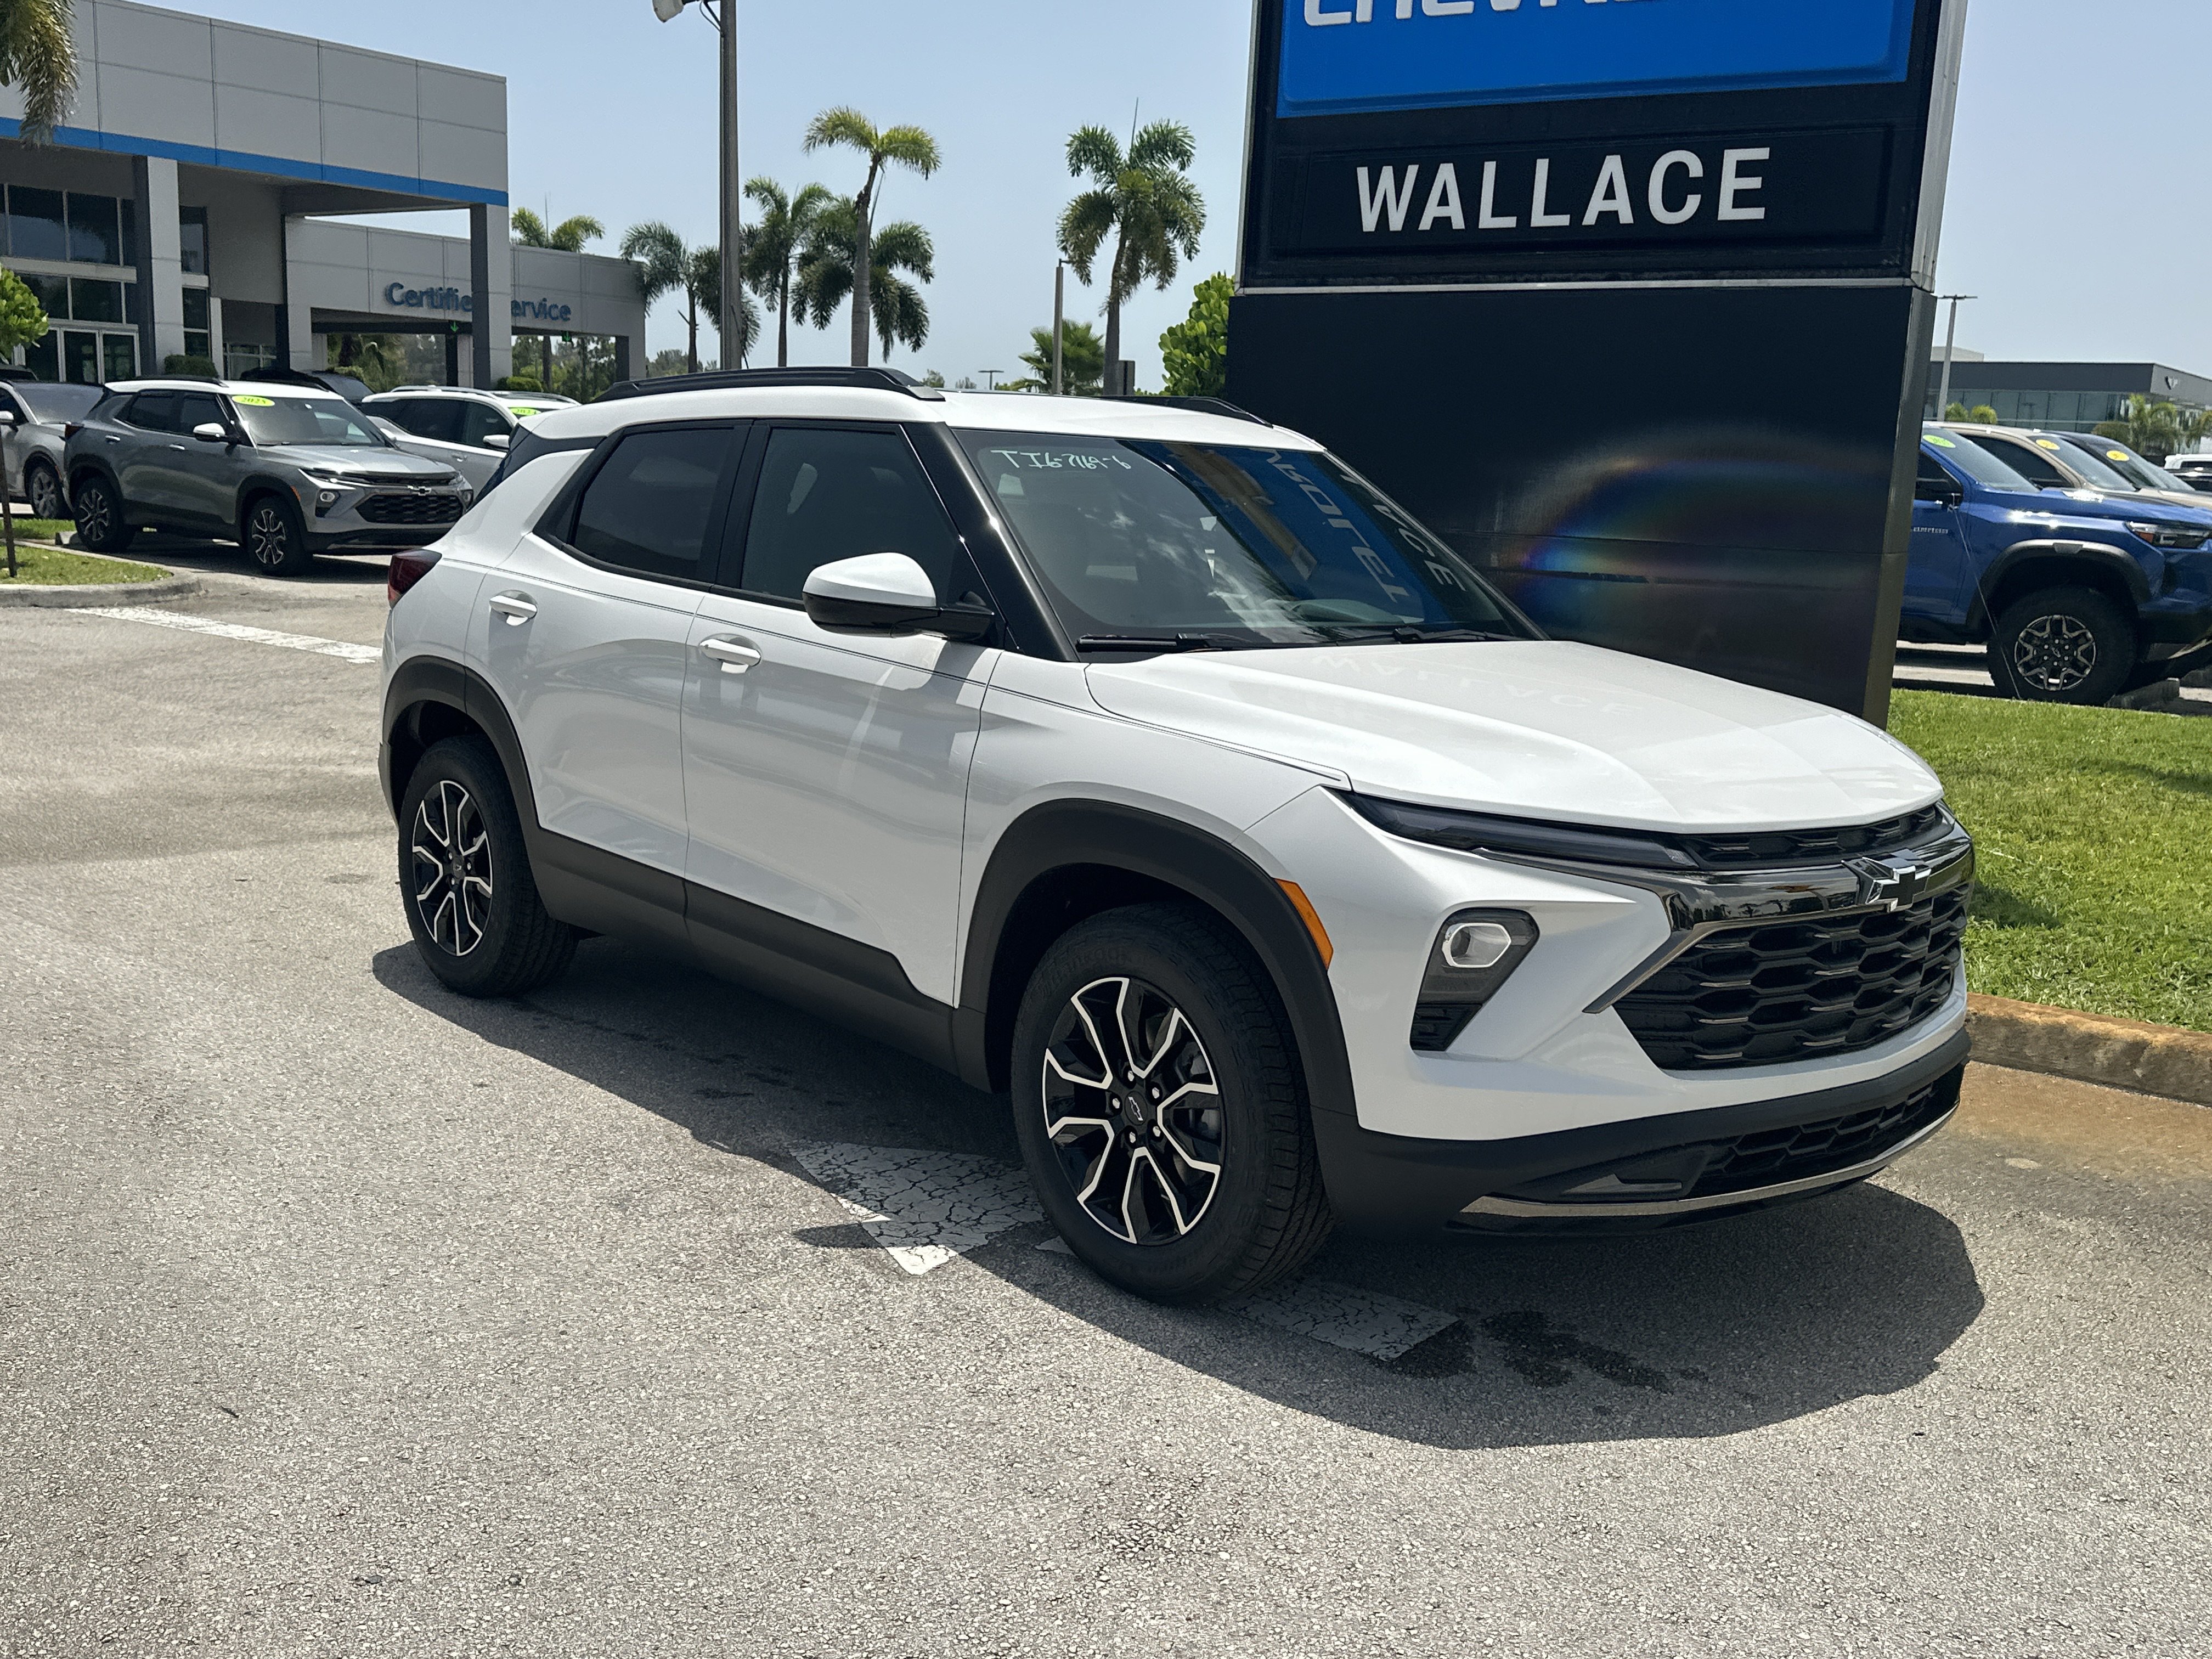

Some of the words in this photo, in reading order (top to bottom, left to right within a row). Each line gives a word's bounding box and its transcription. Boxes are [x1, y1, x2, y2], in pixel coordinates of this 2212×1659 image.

[1356, 146, 1770, 232] WALLACE
[385, 283, 472, 312] Certifie
[511, 297, 571, 321] ervice
